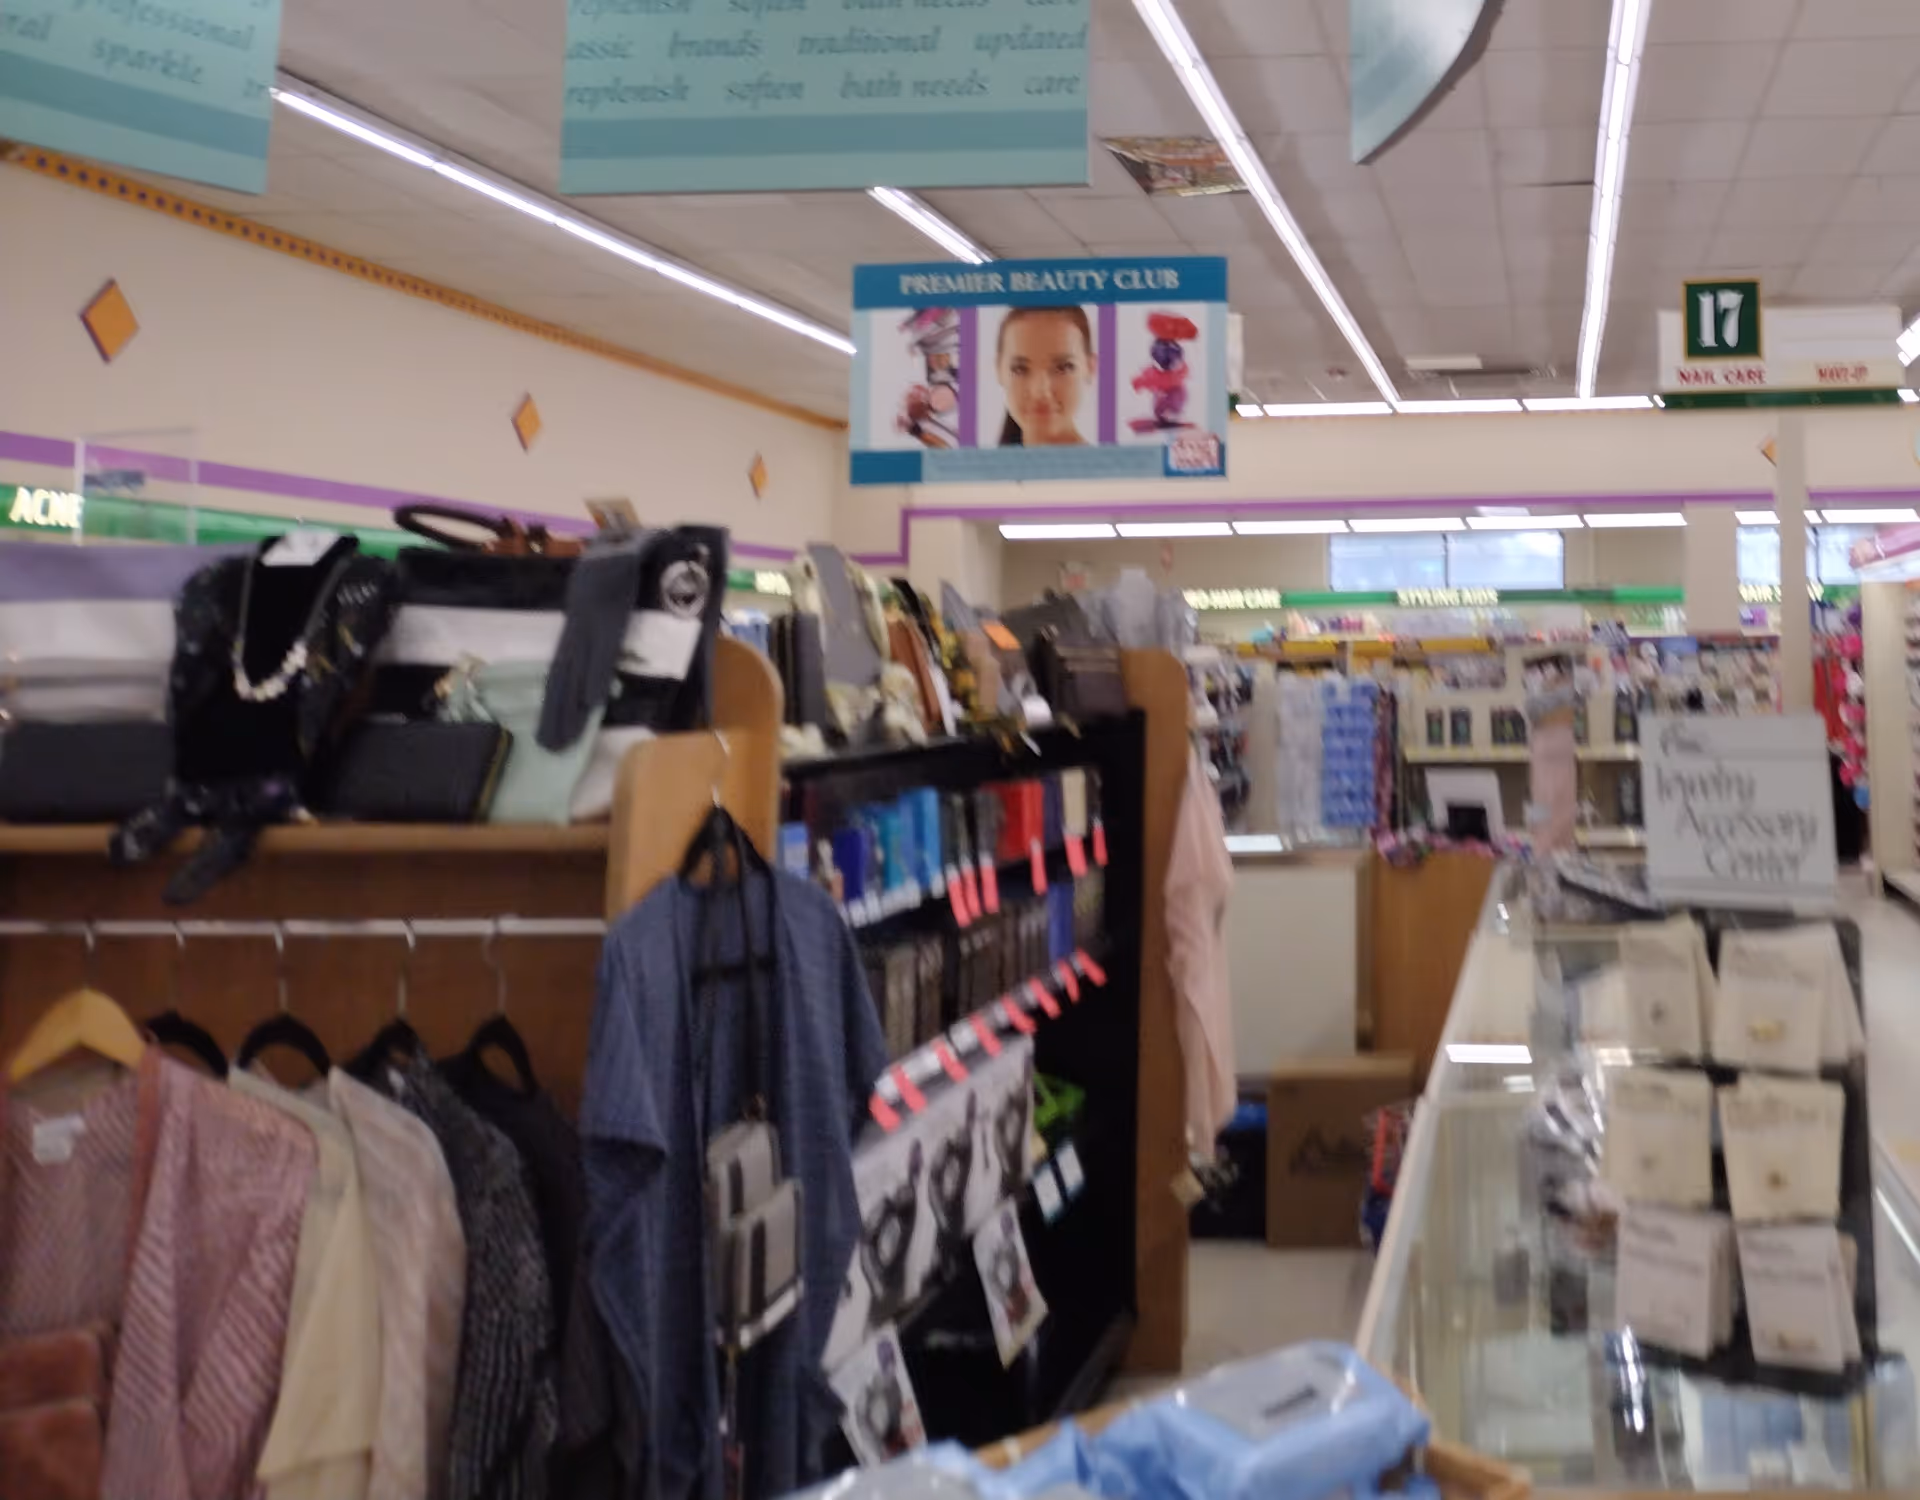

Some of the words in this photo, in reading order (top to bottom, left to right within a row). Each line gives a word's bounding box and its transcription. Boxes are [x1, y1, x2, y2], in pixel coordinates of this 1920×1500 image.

[93, 39, 203, 84] sparkle
[669, 29, 763, 60] brands
[797, 26, 942, 56] traditional
[974, 22, 1089, 61] updated
[567, 75, 690, 112] replenish
[725, 71, 805, 110] soften
[840, 70, 902, 98] bath
[911, 68, 991, 97] needs
[1023, 74, 1081, 95] care
[899, 273, 1004, 295] PREMIER
[1010, 271, 1106, 292] BEAUTY
[1112, 268, 1180, 290] CLUB
[1697, 289, 1744, 347] 17
[1677, 367, 1716, 385] NAIL
[1724, 366, 1766, 385] CARE
[9, 486, 84, 528] ACNE
